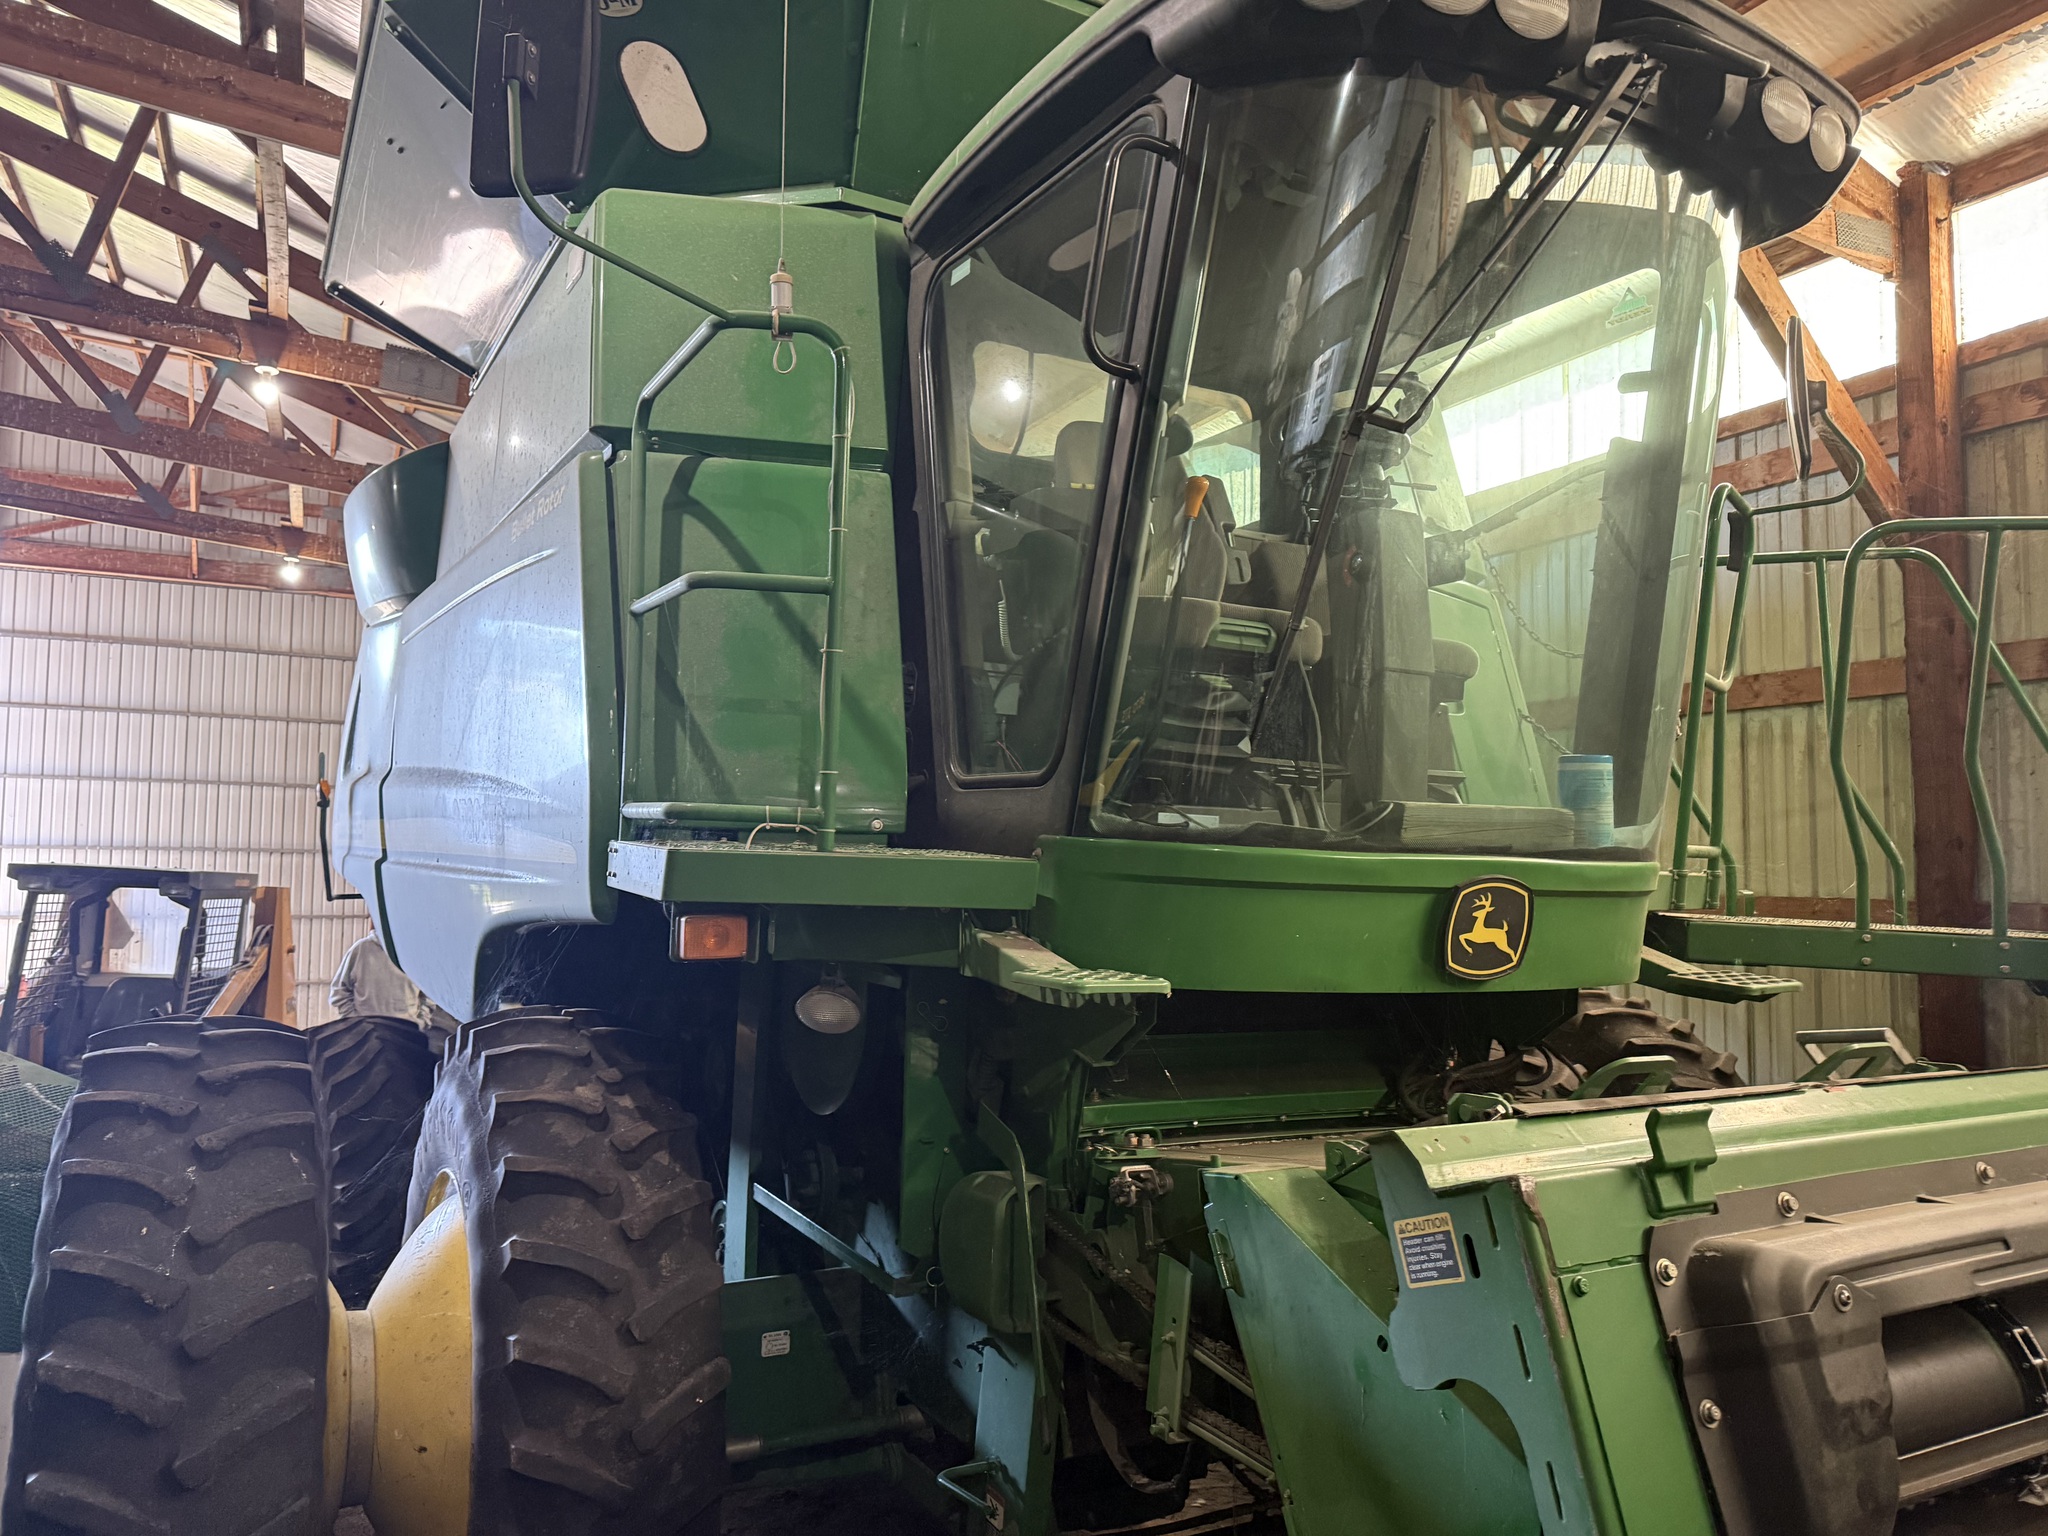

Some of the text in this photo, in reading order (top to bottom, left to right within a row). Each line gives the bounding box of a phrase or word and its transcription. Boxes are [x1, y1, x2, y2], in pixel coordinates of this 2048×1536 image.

[537, 484, 566, 521] Rotor
[1405, 1216, 1449, 1233] CAUTION
[1403, 1237, 1422, 1246] Header
[1405, 1243, 1447, 1254] Avoid crushing
[1407, 1252, 1443, 1263] injuries. Stay
[1408, 1263, 1421, 1271] clear
[1435, 1259, 1454, 1268] engine
[1410, 1271, 1417, 1279] is
